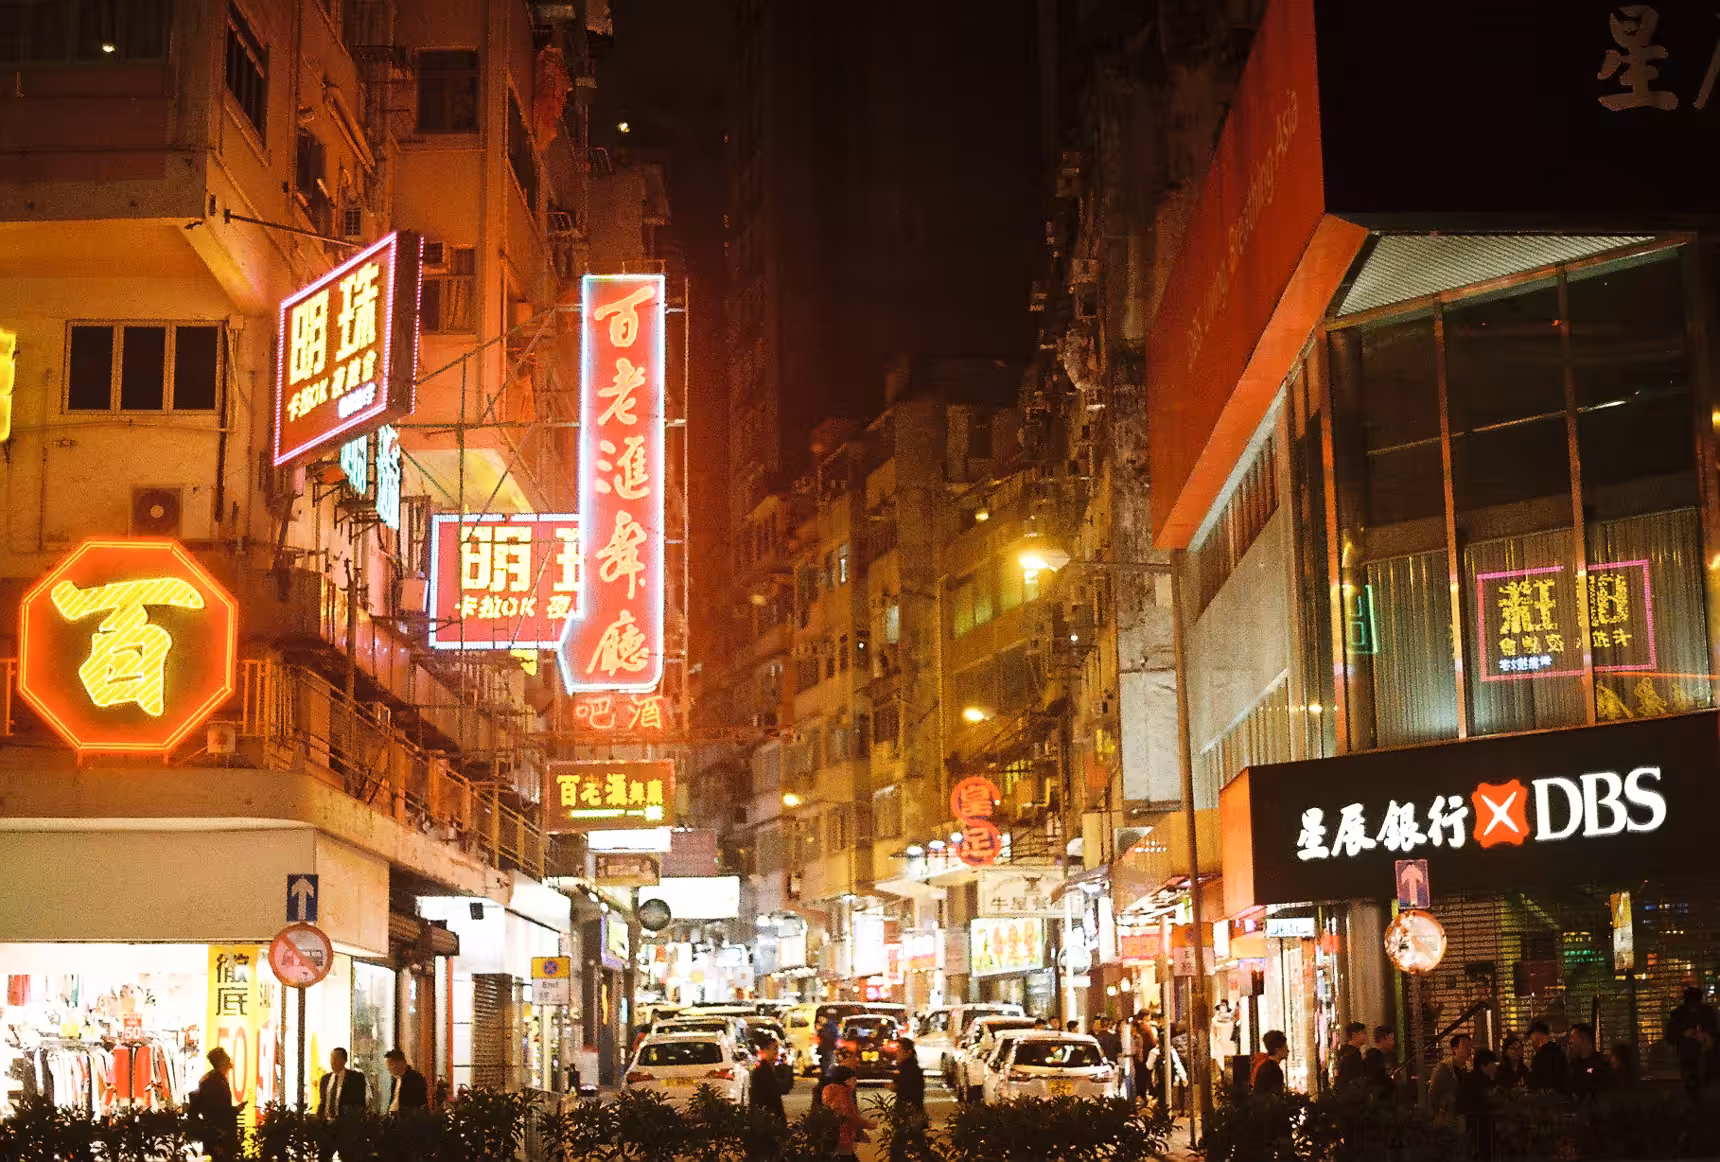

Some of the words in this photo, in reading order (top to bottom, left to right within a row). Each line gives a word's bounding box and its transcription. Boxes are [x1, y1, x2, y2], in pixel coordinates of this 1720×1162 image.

[1597, 5, 1720, 111] 星
[290, 261, 380, 386] 明珠
[51, 577, 205, 717] 百
[1296, 794, 1469, 861] 星展銀行
[1531, 766, 1667, 842] DBS
